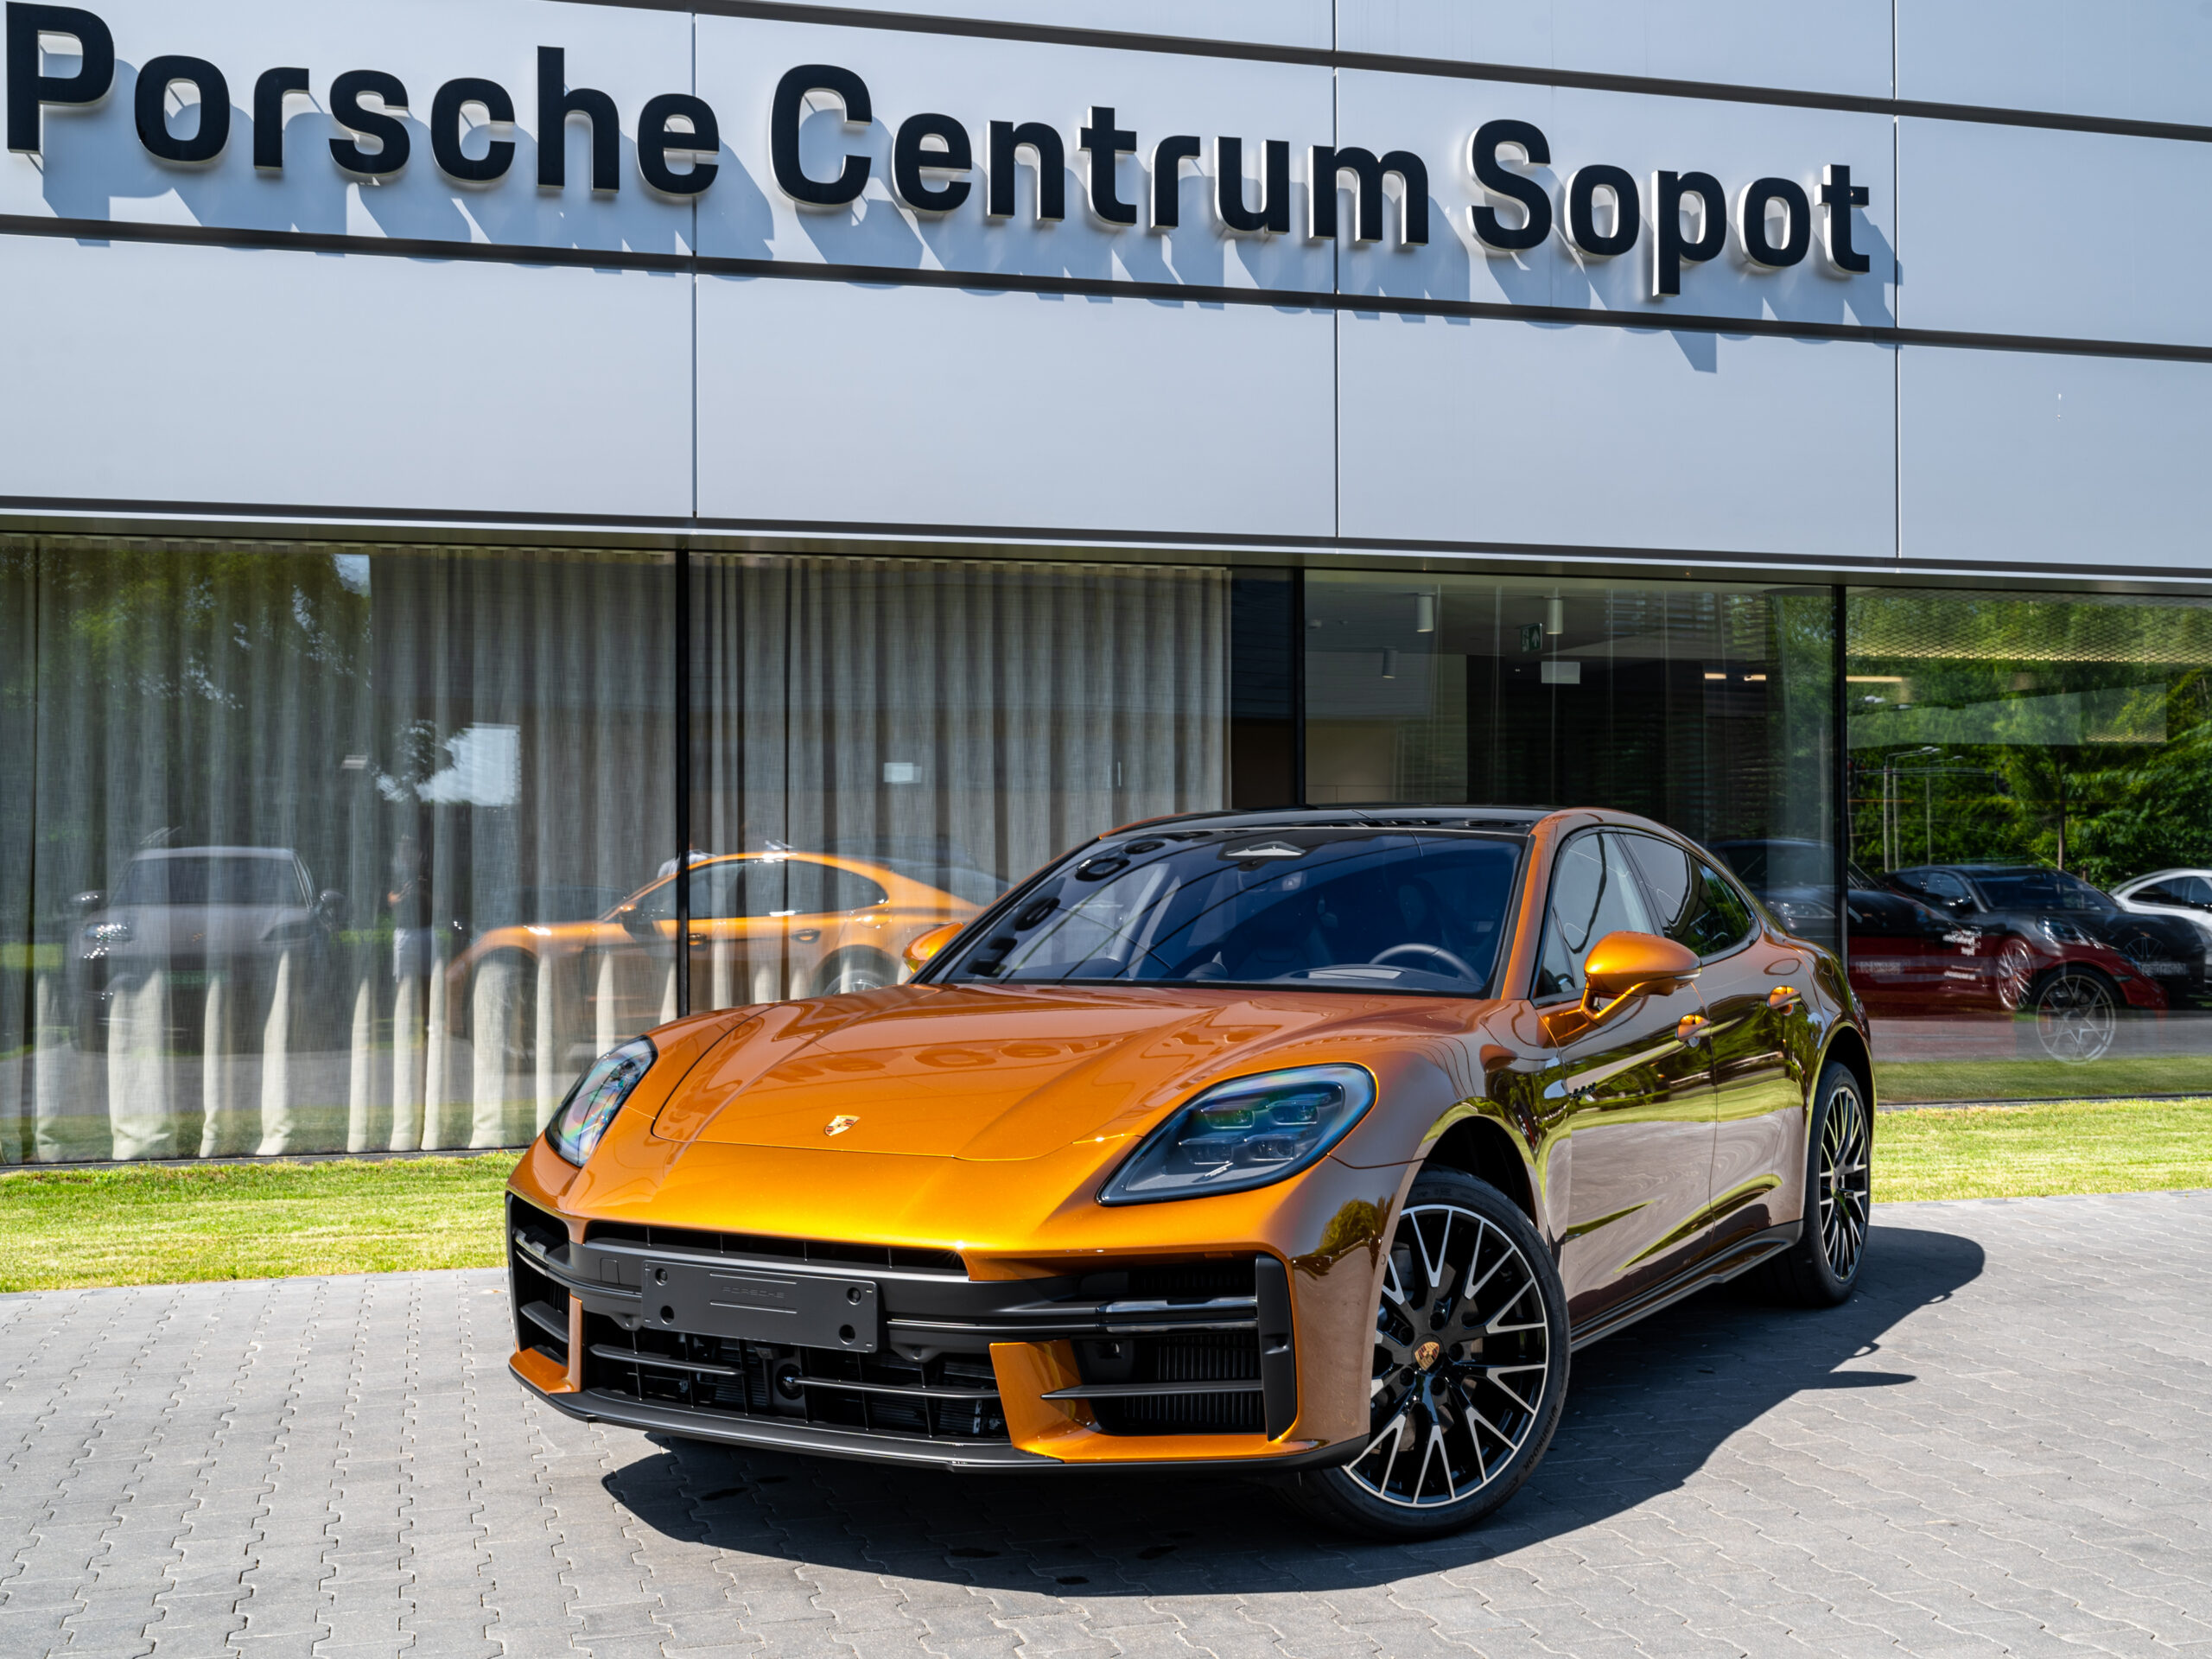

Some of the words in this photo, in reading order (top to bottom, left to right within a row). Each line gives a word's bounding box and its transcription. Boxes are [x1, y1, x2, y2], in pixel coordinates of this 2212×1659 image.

[5, 2, 721, 197] Porsche
[771, 63, 1430, 247] Centrum
[1466, 118, 1871, 297] Sopot
